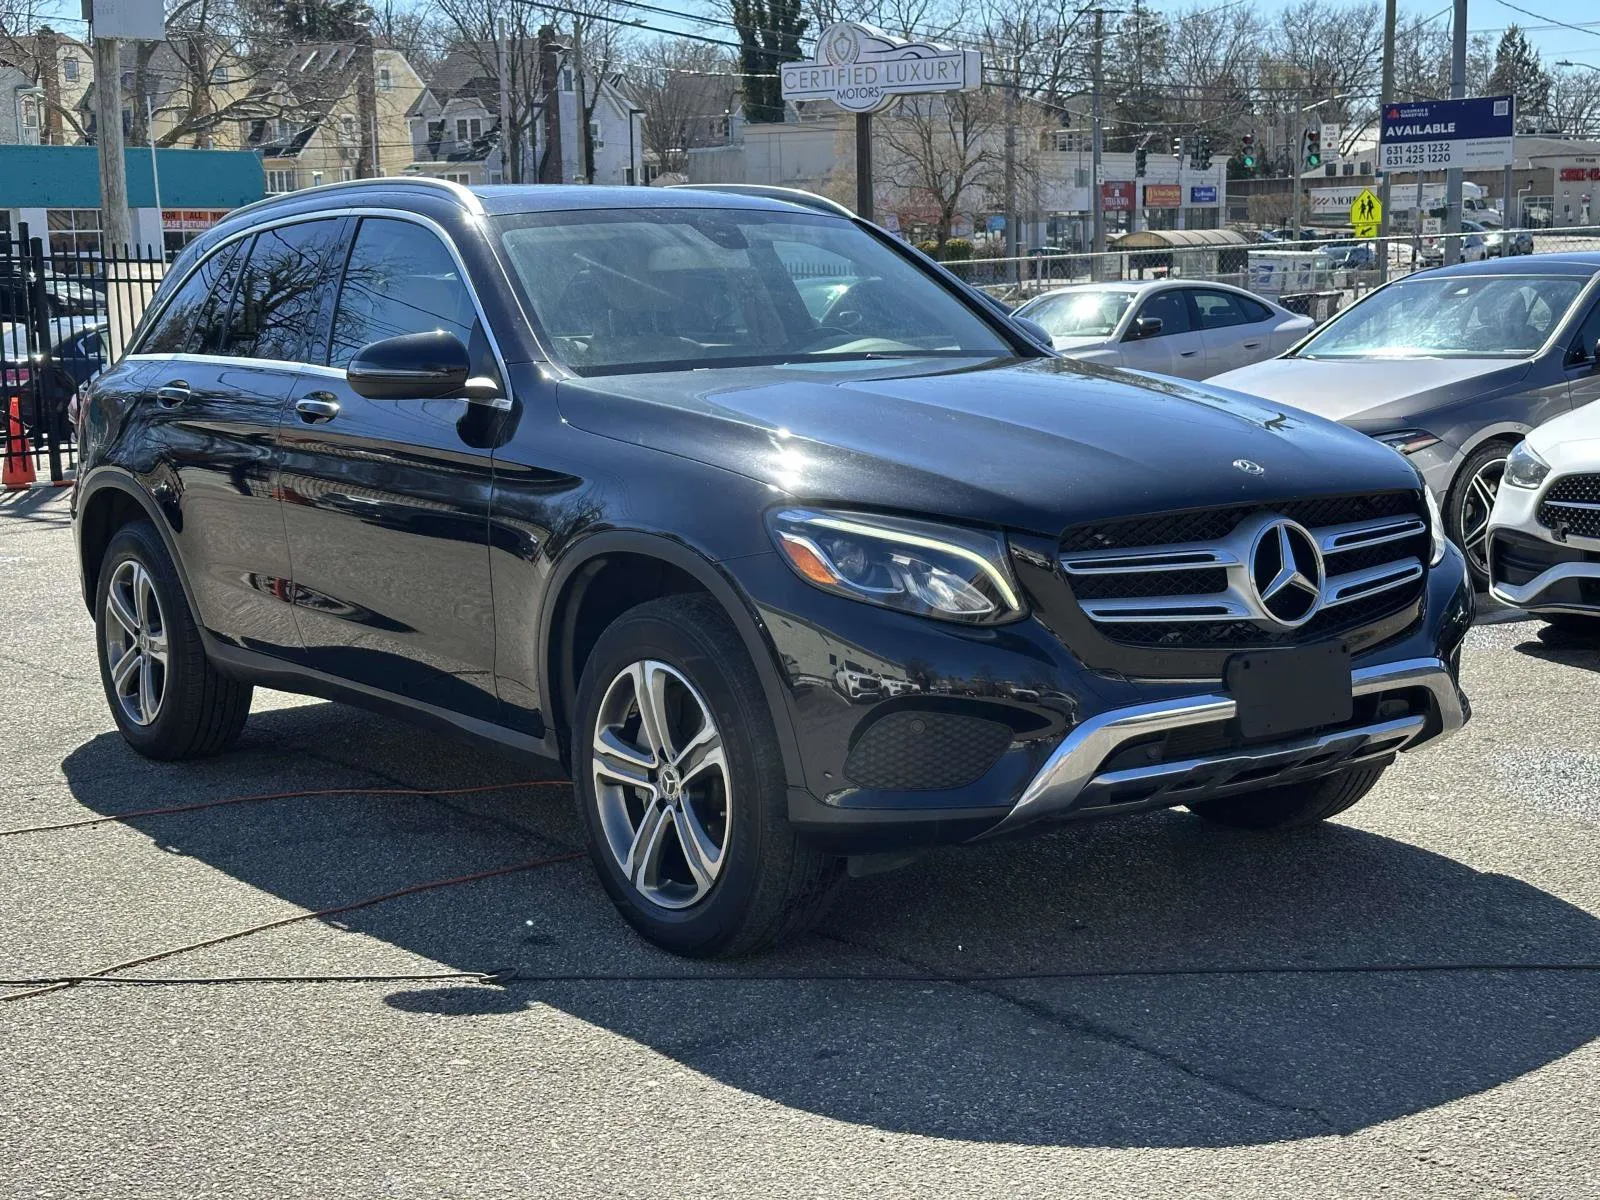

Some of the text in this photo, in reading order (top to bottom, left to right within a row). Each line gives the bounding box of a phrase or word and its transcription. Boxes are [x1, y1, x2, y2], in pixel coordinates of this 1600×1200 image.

[783, 60, 962, 90] CERTIFIED LUXURY
[836, 86, 880, 100] MOTORS
[1386, 122, 1456, 137] AVAILABLE
[1386, 142, 1450, 155] 631 425 1232
[1386, 153, 1451, 165] 631 425 1220
[162, 212, 176, 220] FOR
[189, 211, 203, 220] ALL
